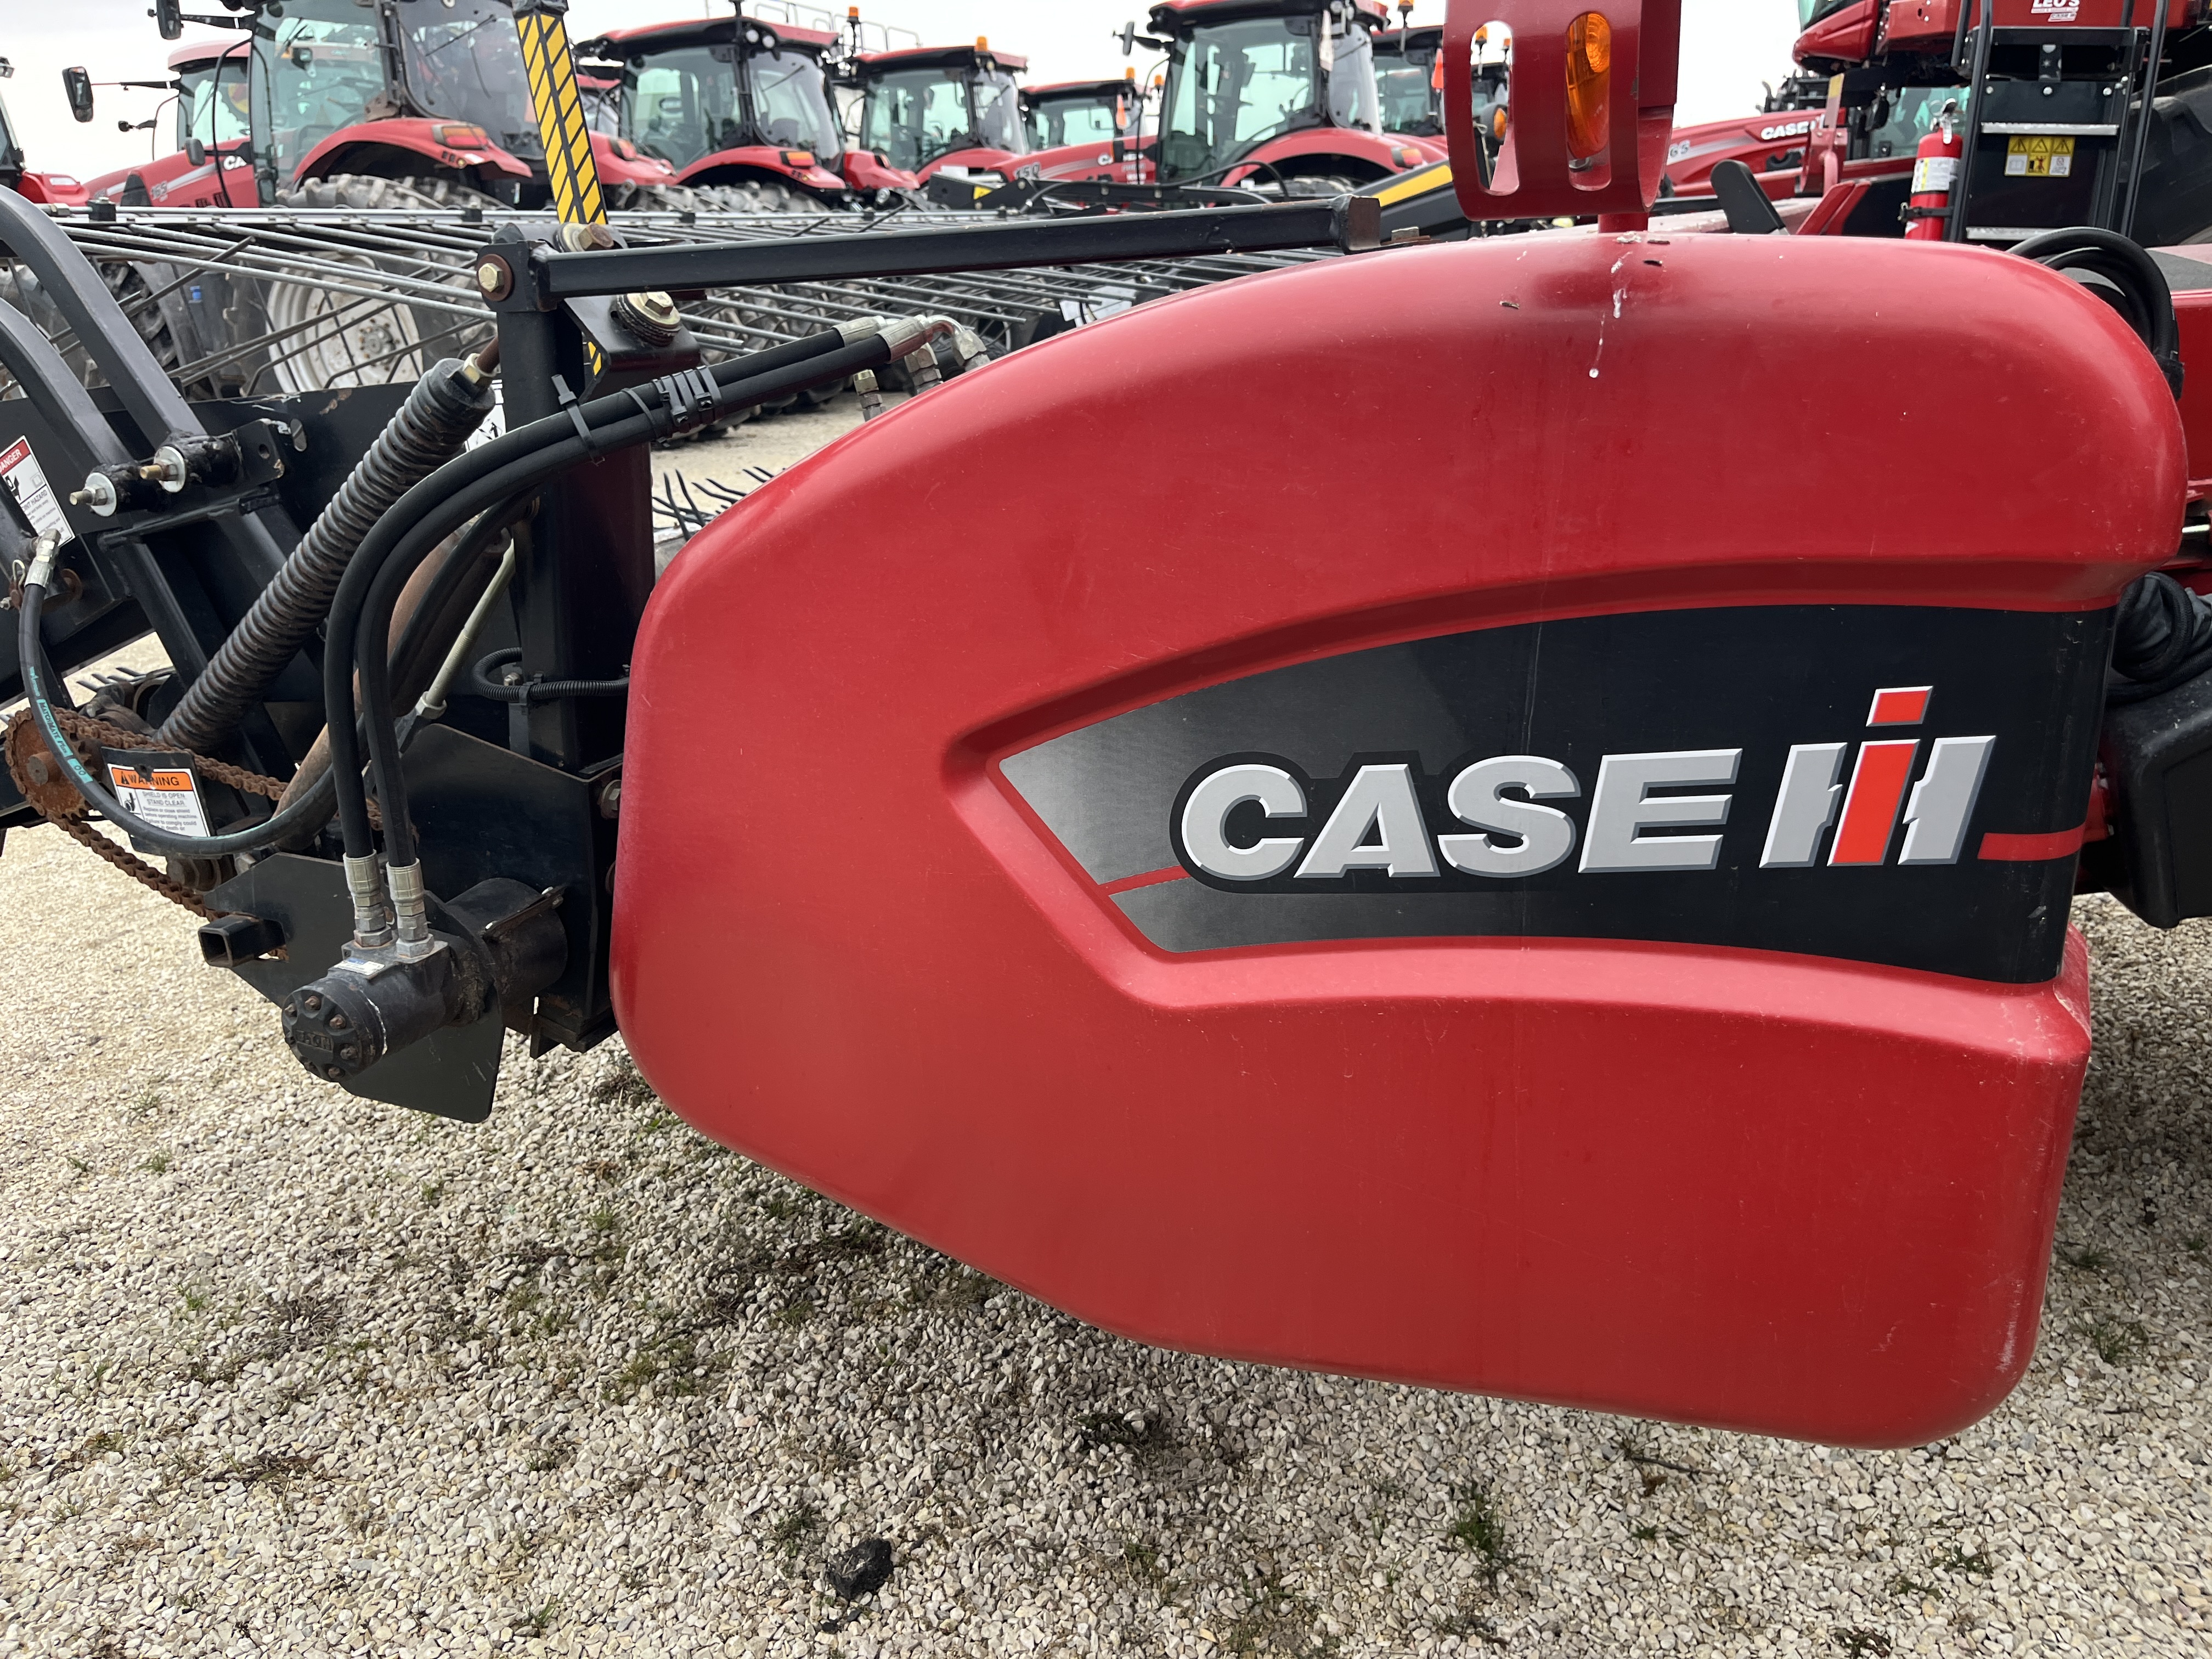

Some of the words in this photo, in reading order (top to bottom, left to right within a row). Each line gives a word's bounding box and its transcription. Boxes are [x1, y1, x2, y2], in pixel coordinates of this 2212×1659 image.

[1760, 121, 1809, 140] CASE
[128, 774, 180, 786] WANING
[1181, 748, 1743, 880] CASE
[1759, 685, 1997, 868] IH
